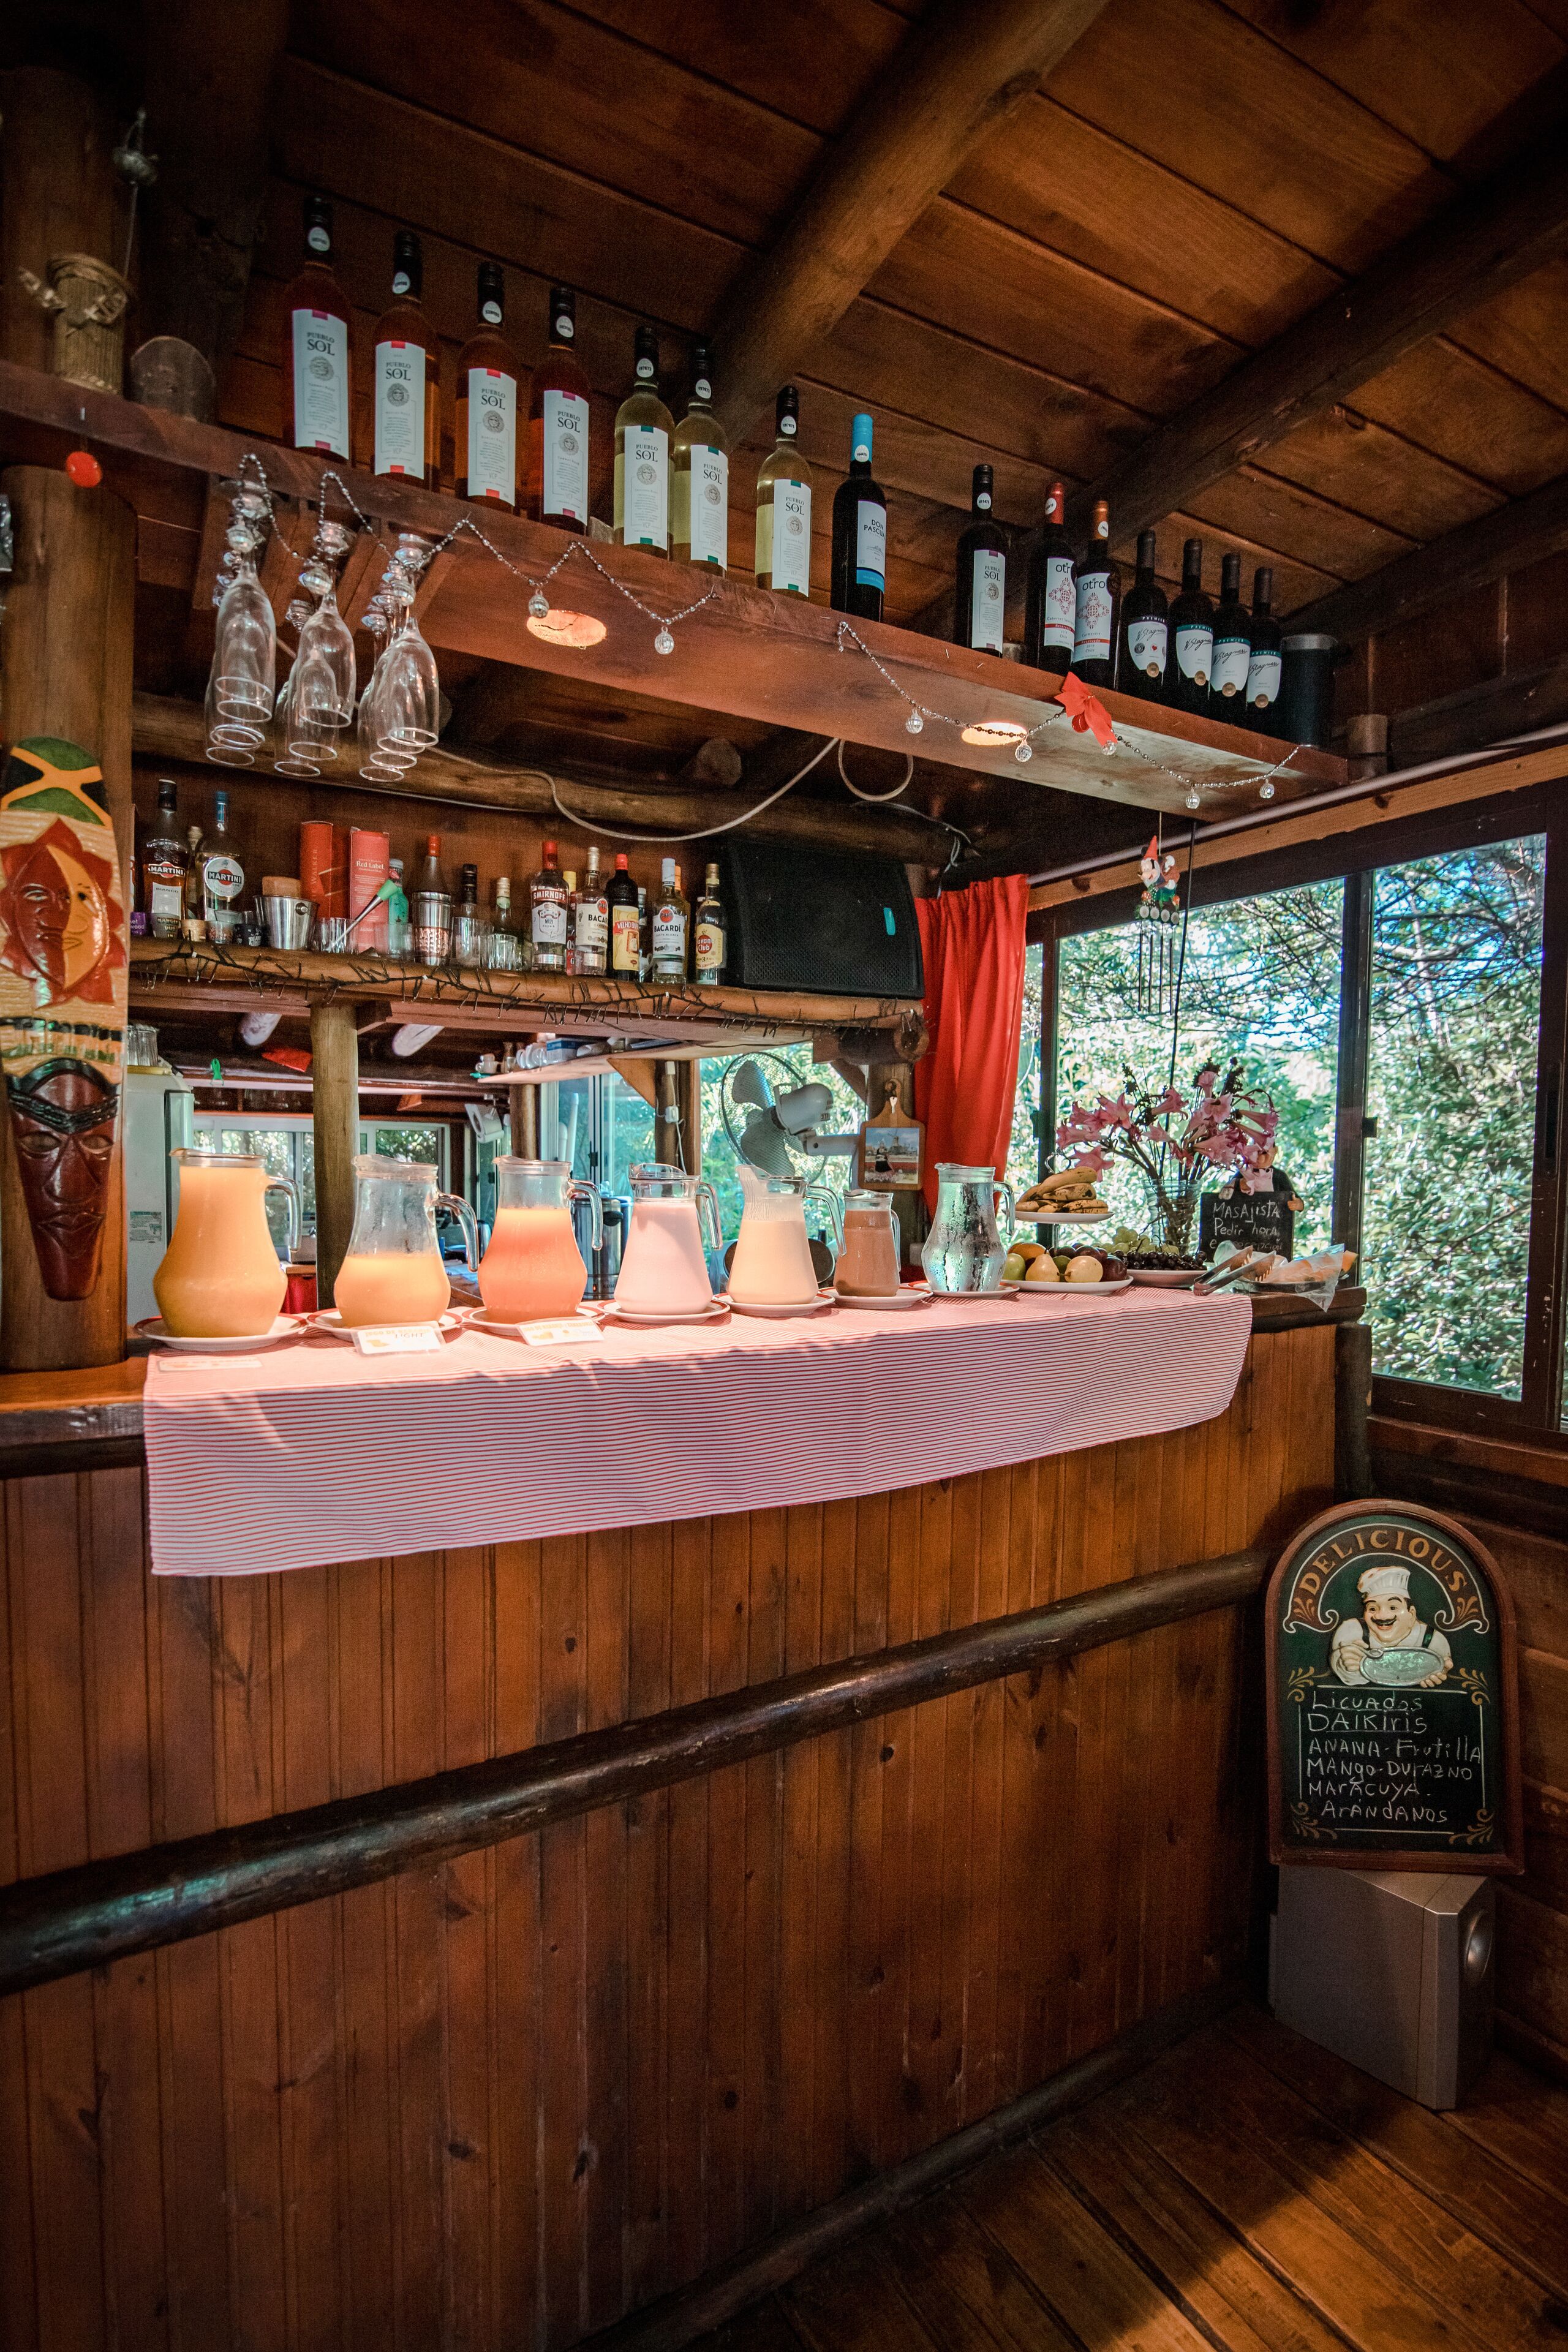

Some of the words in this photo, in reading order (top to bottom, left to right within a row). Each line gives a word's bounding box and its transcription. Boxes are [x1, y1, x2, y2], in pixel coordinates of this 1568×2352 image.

[307, 331, 335, 344] PUEBLO
[307, 339, 335, 356] SOL
[386, 368, 411, 381] SOL
[481, 388, 505, 398] PUEBLO
[481, 394, 505, 410] SOL
[557, 410, 581, 421] PUEBLO
[557, 417, 580, 433] SOL
[636, 450, 658, 462] SOL
[703, 463, 722, 474] PUEBLO
[703, 469, 722, 484] SOL
[786, 497, 804, 506] PUEBLO
[785, 502, 804, 516] SOL
[871, 519, 884, 530] DON
[1055, 564, 1071, 574] otr
[984, 570, 1001, 582] SOL
[1082, 581, 1106, 591] otro
[151, 865, 184, 875] MARTINI
[208, 872, 241, 883] MARTINI
[533, 891, 565, 901] SMIRNOFF
[654, 924, 680, 932] BACARDÍ
[1214, 1217, 1244, 1236] Pedir
[1299, 1530, 1468, 1596] DELICIOUS
